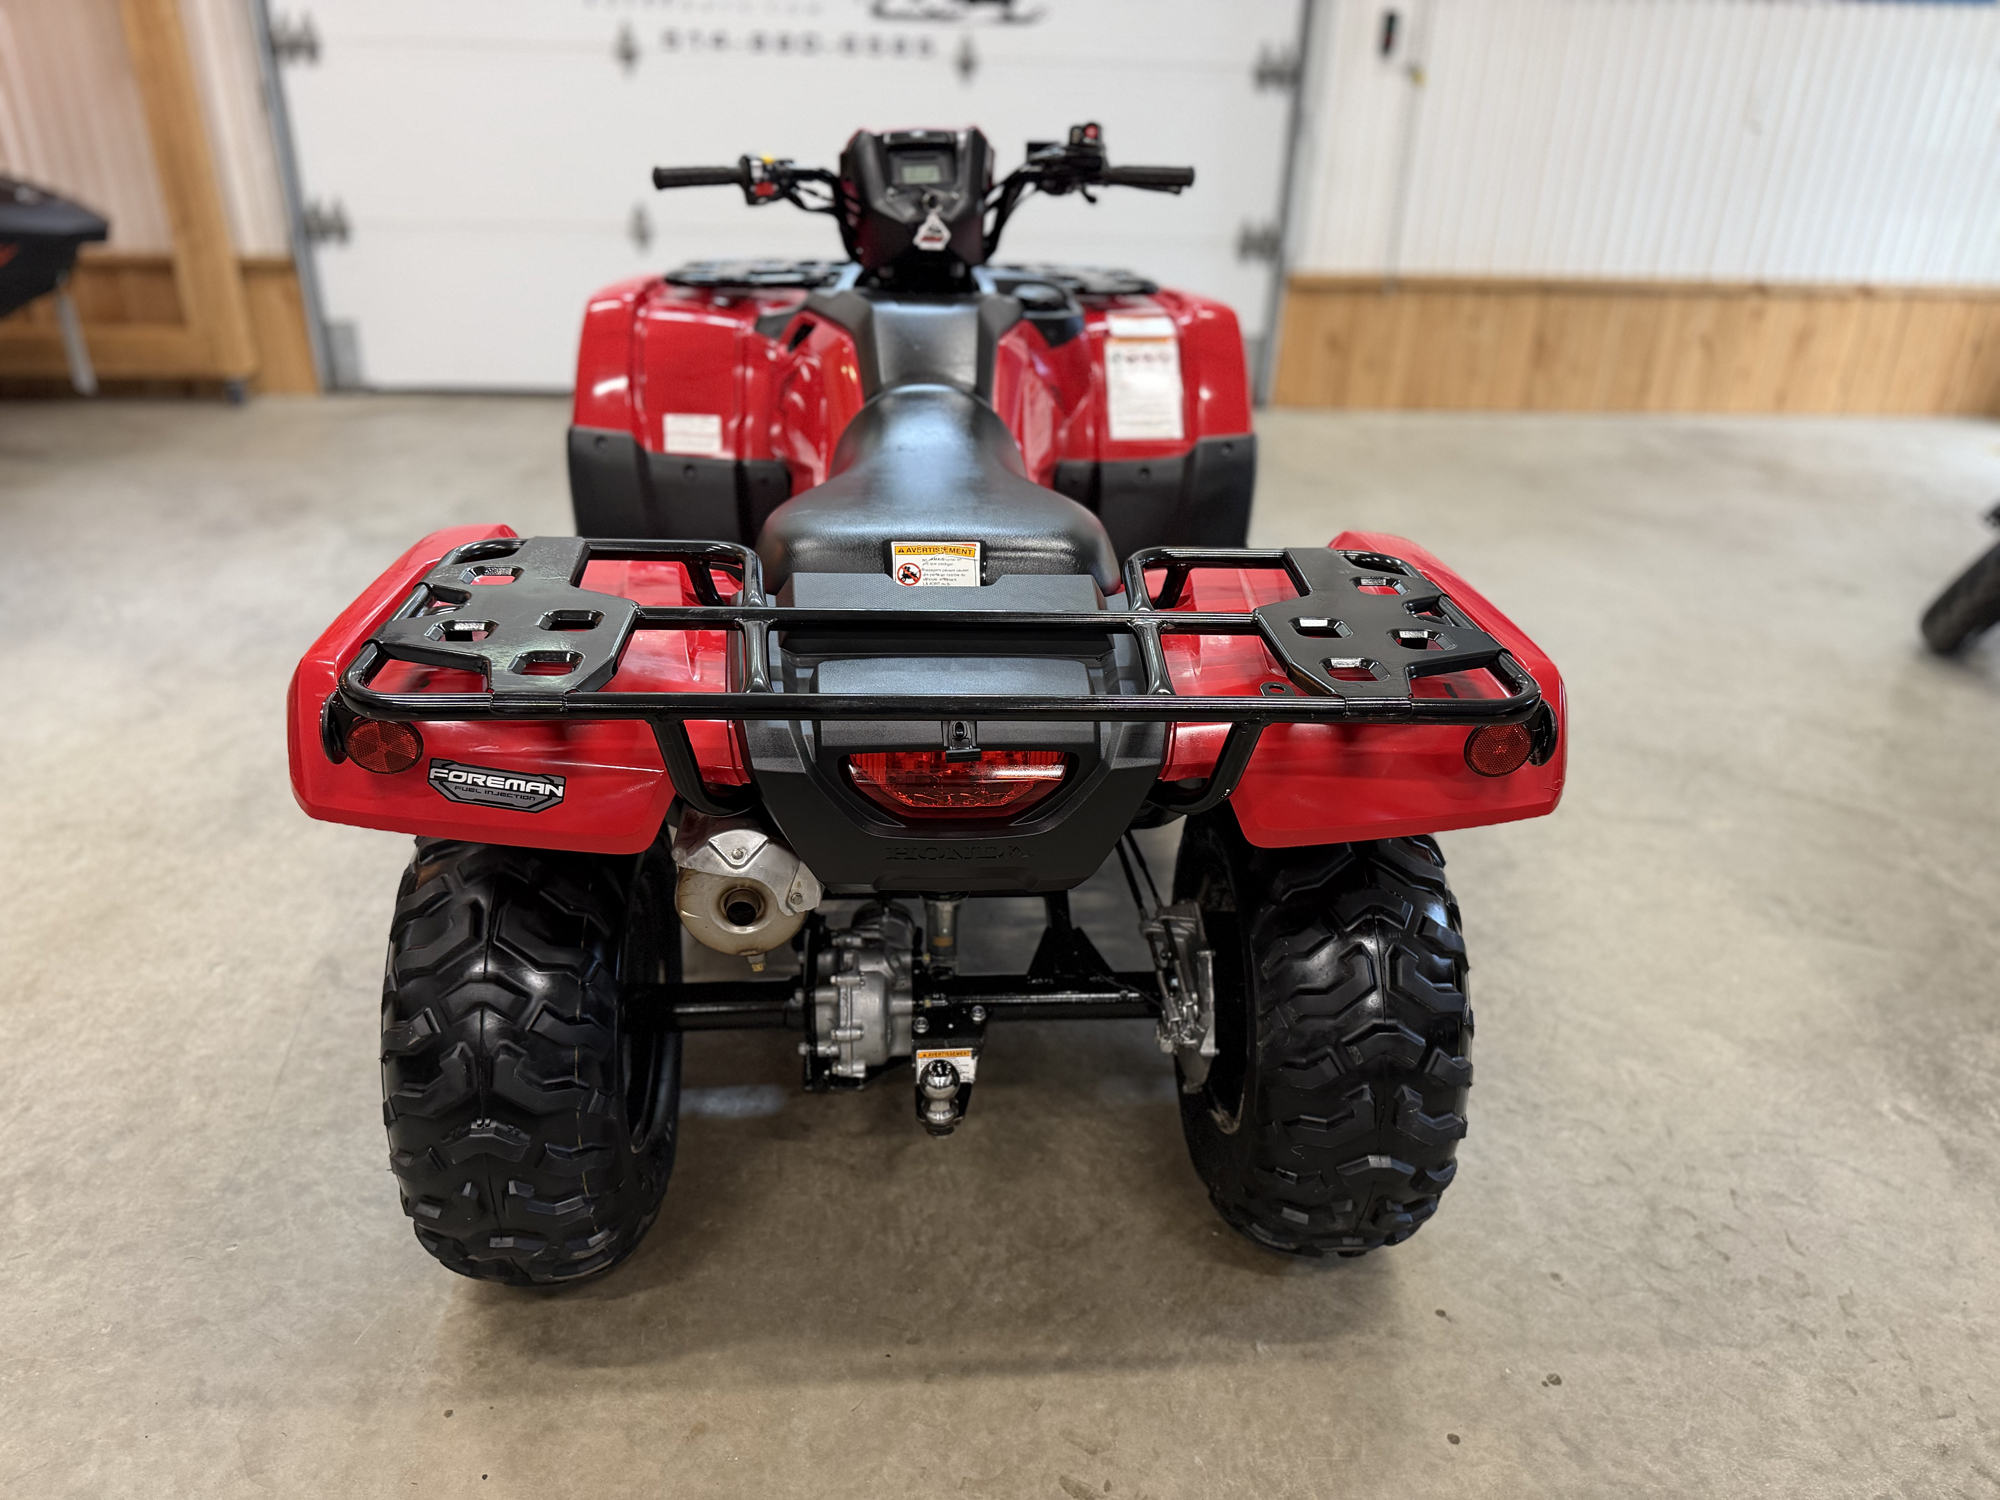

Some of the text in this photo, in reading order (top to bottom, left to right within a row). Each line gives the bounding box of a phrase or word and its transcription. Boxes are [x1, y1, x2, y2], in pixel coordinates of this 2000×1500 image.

[430, 768, 563, 797] FOREMAN
[455, 786, 535, 801] FUEL INJECTION
[886, 846, 1034, 860] HONDA
